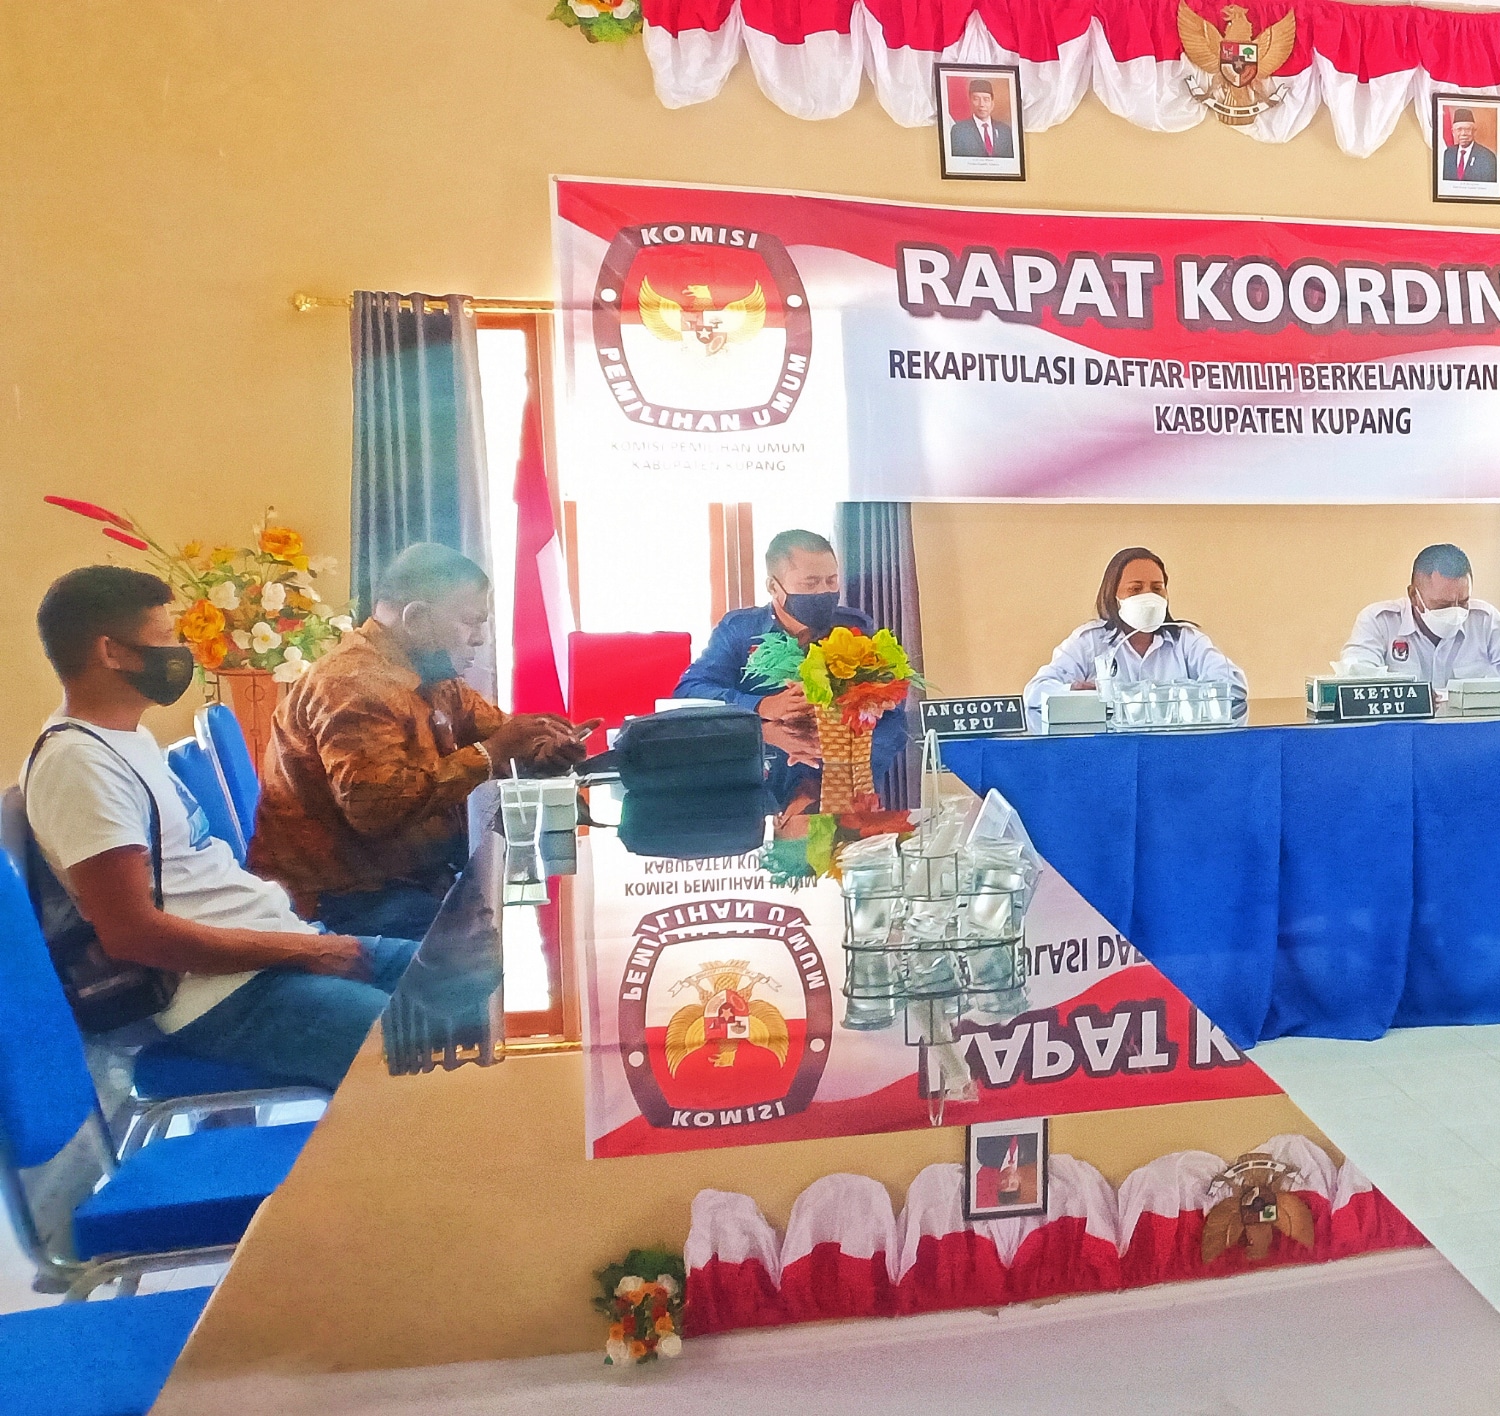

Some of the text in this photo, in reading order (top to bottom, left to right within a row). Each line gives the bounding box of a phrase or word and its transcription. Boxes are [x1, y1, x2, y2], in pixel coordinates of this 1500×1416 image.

[641, 225, 758, 249] KOMISI
[903, 247, 1155, 319] RAPAT
[888, 349, 1076, 386] REKAPITULASI
[1085, 357, 1185, 389] DAFTAR
[1191, 363, 1293, 391] PEMILIH
[1302, 364, 1498, 391] BERKELANJUTAN
[600, 347, 807, 432] PEMILIHAN UMUM
[1155, 405, 1412, 435] KABUPATEN KUPANG
[611, 441, 806, 453] KOMISI PEMILHAN UMUM
[726, 460, 787, 471] KUPANG
[1353, 686, 1418, 700] KETUA
[926, 701, 1018, 717] ANGGOTA
[1368, 702, 1405, 715] KPU
[953, 717, 995, 731] KPU
